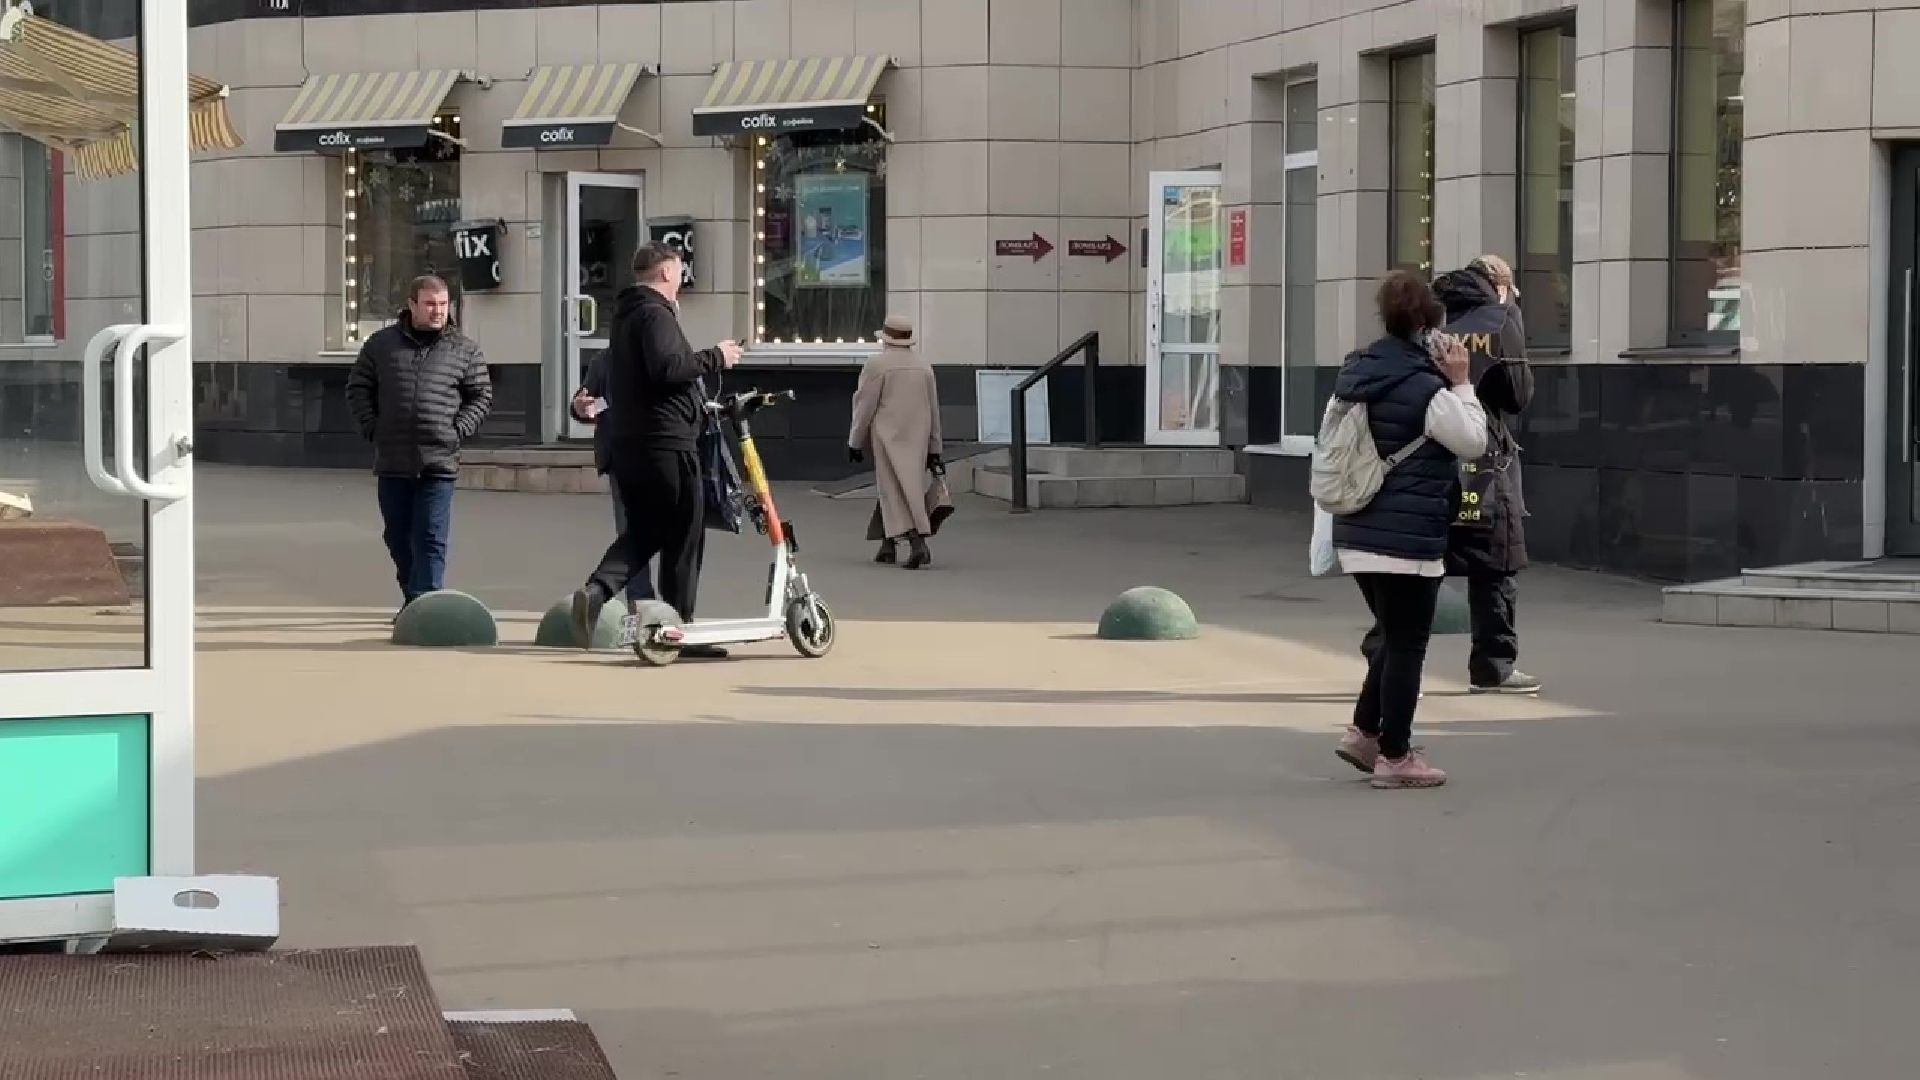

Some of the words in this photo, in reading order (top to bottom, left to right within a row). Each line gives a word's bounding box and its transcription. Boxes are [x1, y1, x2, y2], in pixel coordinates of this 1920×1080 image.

[741, 113, 776, 129] cofix
[318, 130, 352, 146] cofix
[540, 126, 575, 143] cofix
